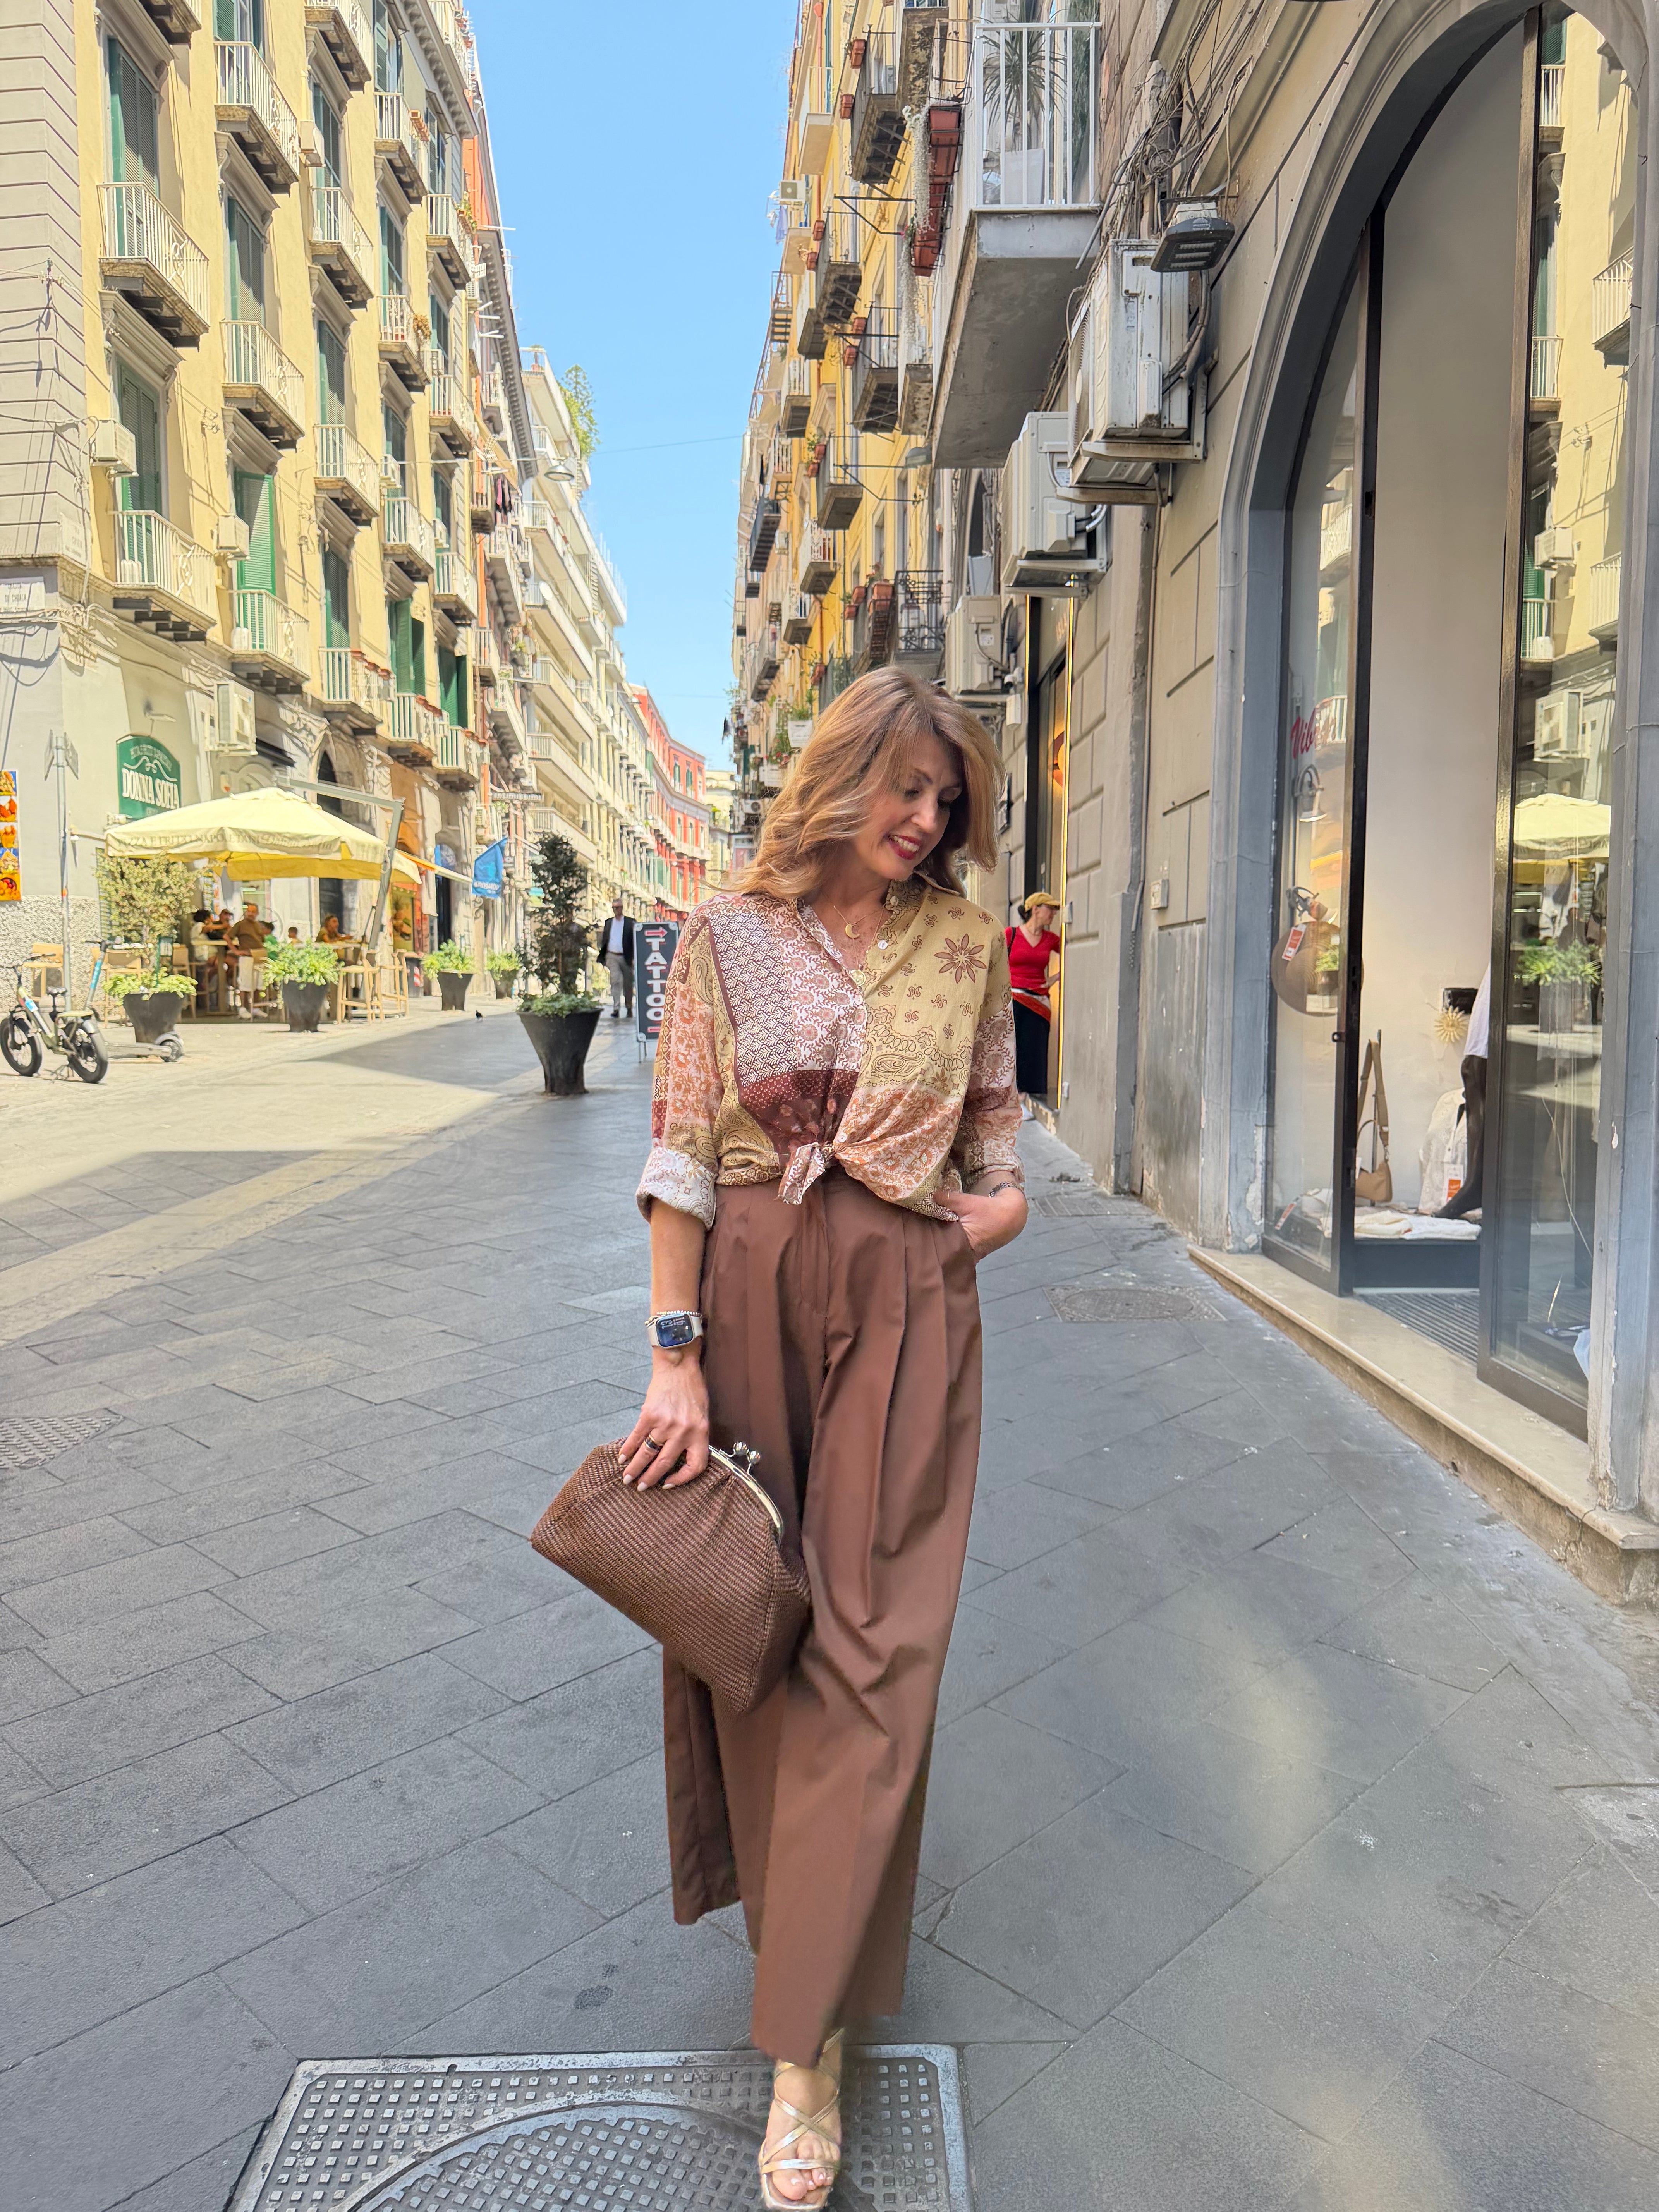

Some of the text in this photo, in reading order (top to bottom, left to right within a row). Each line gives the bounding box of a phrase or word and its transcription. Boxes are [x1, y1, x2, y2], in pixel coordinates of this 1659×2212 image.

[122, 768, 179, 809] DONNA SOFIA
[644, 938, 668, 1021] TATTOO
